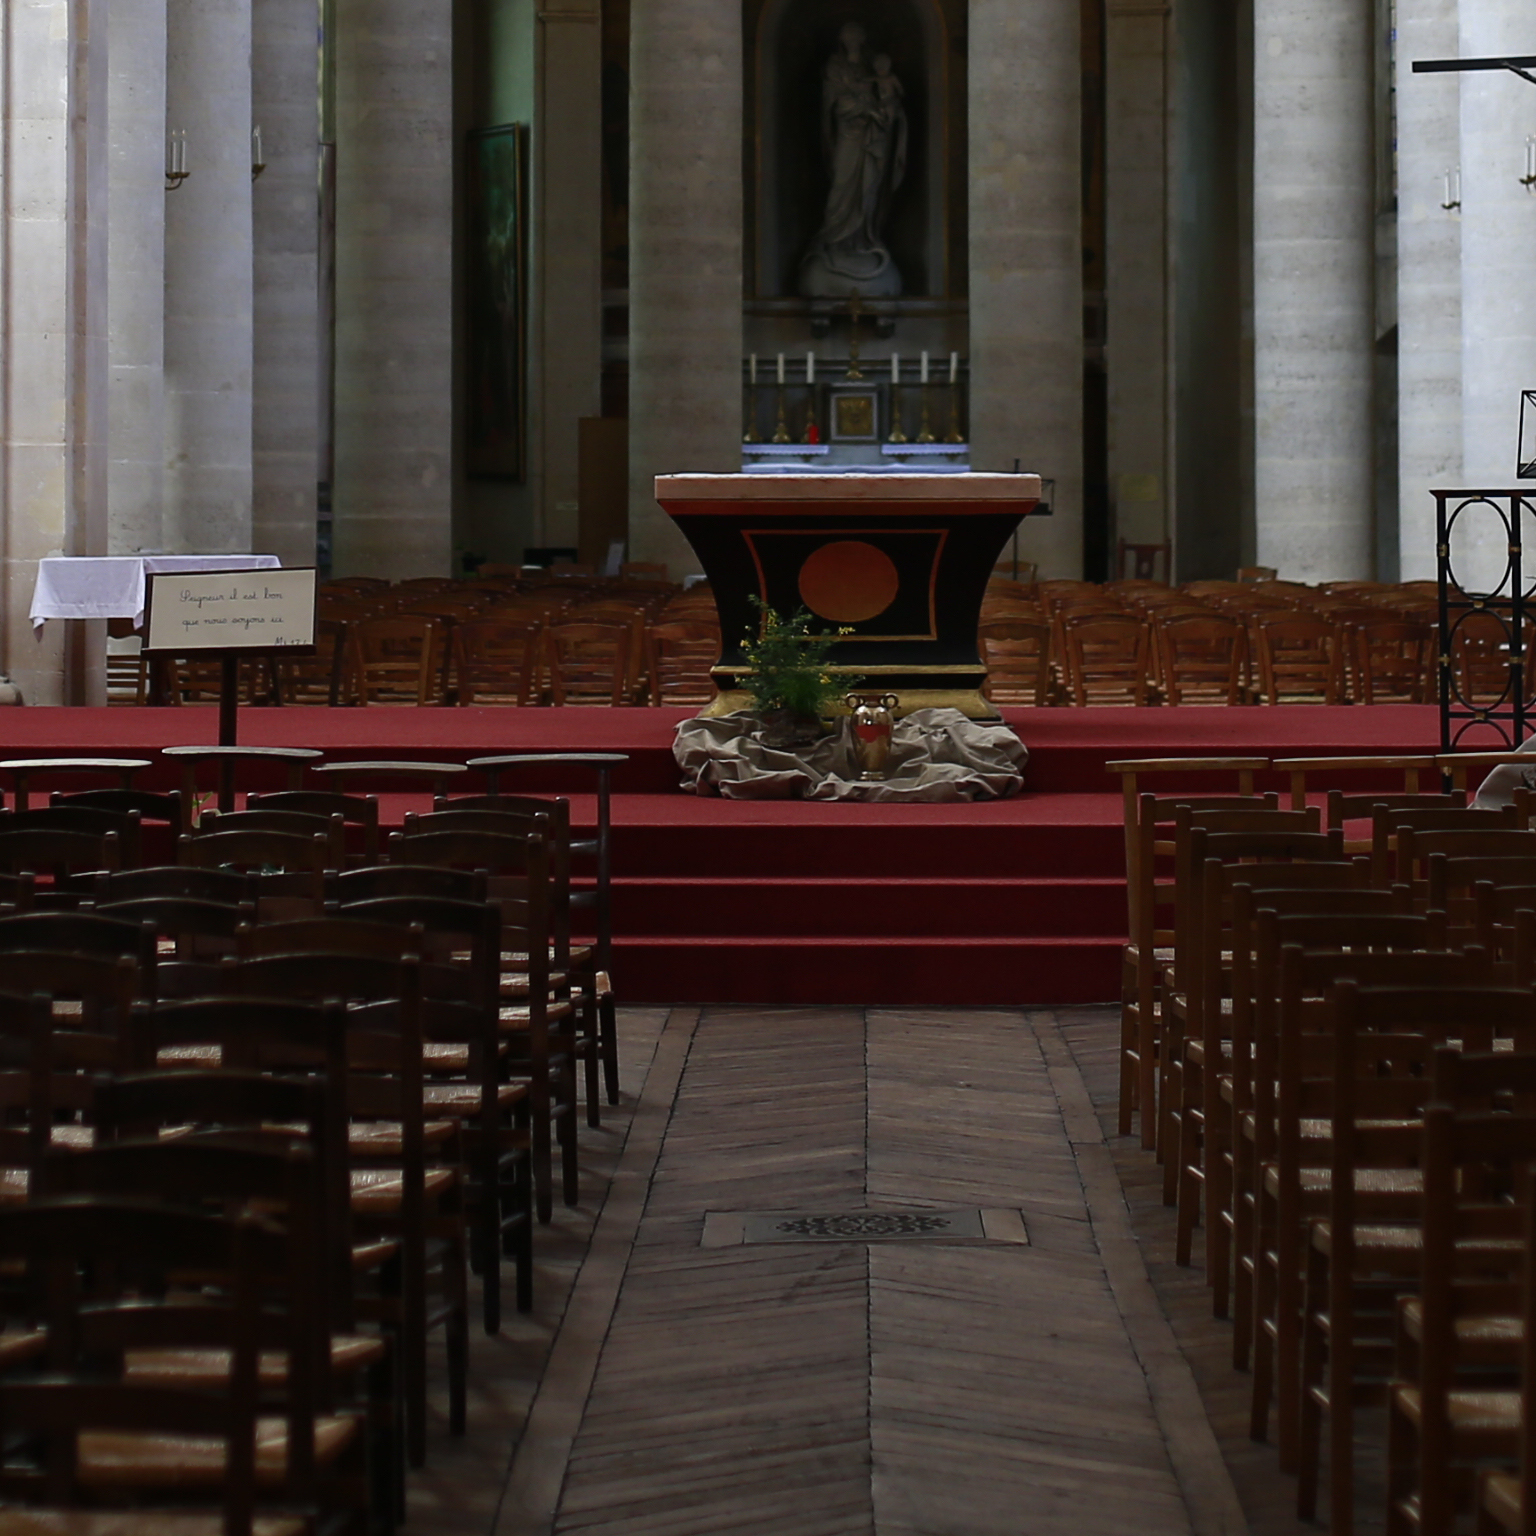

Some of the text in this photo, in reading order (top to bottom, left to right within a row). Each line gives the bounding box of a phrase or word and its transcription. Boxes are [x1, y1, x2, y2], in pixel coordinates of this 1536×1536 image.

[180, 587, 283, 608] Seigneur il est bon
[182, 620, 199, 632] que
[231, 617, 265, 630] soyons
